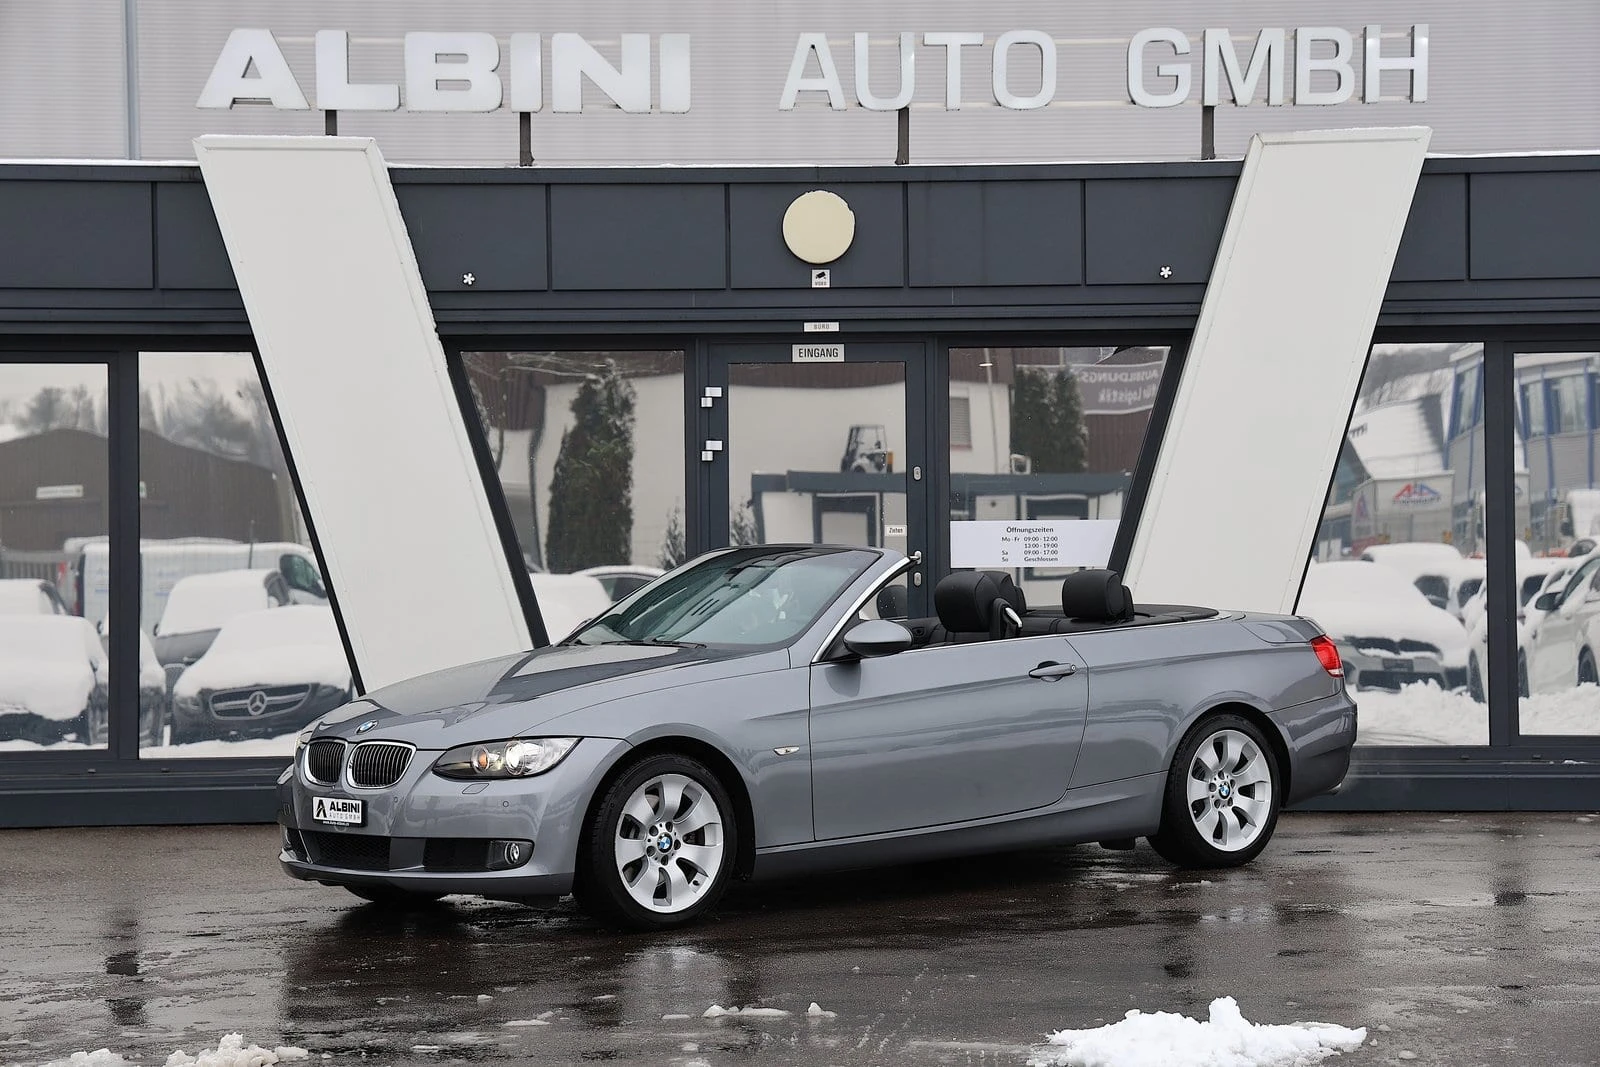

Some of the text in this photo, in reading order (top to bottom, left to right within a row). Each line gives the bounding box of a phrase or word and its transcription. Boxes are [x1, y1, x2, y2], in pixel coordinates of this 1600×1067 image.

[196, 24, 1429, 113] ALBINI AUTO GMBH
[798, 348, 839, 358] EINGANG
[1006, 526, 1054, 534] Öffnungszeiten
[330, 801, 360, 813] ALBINI
